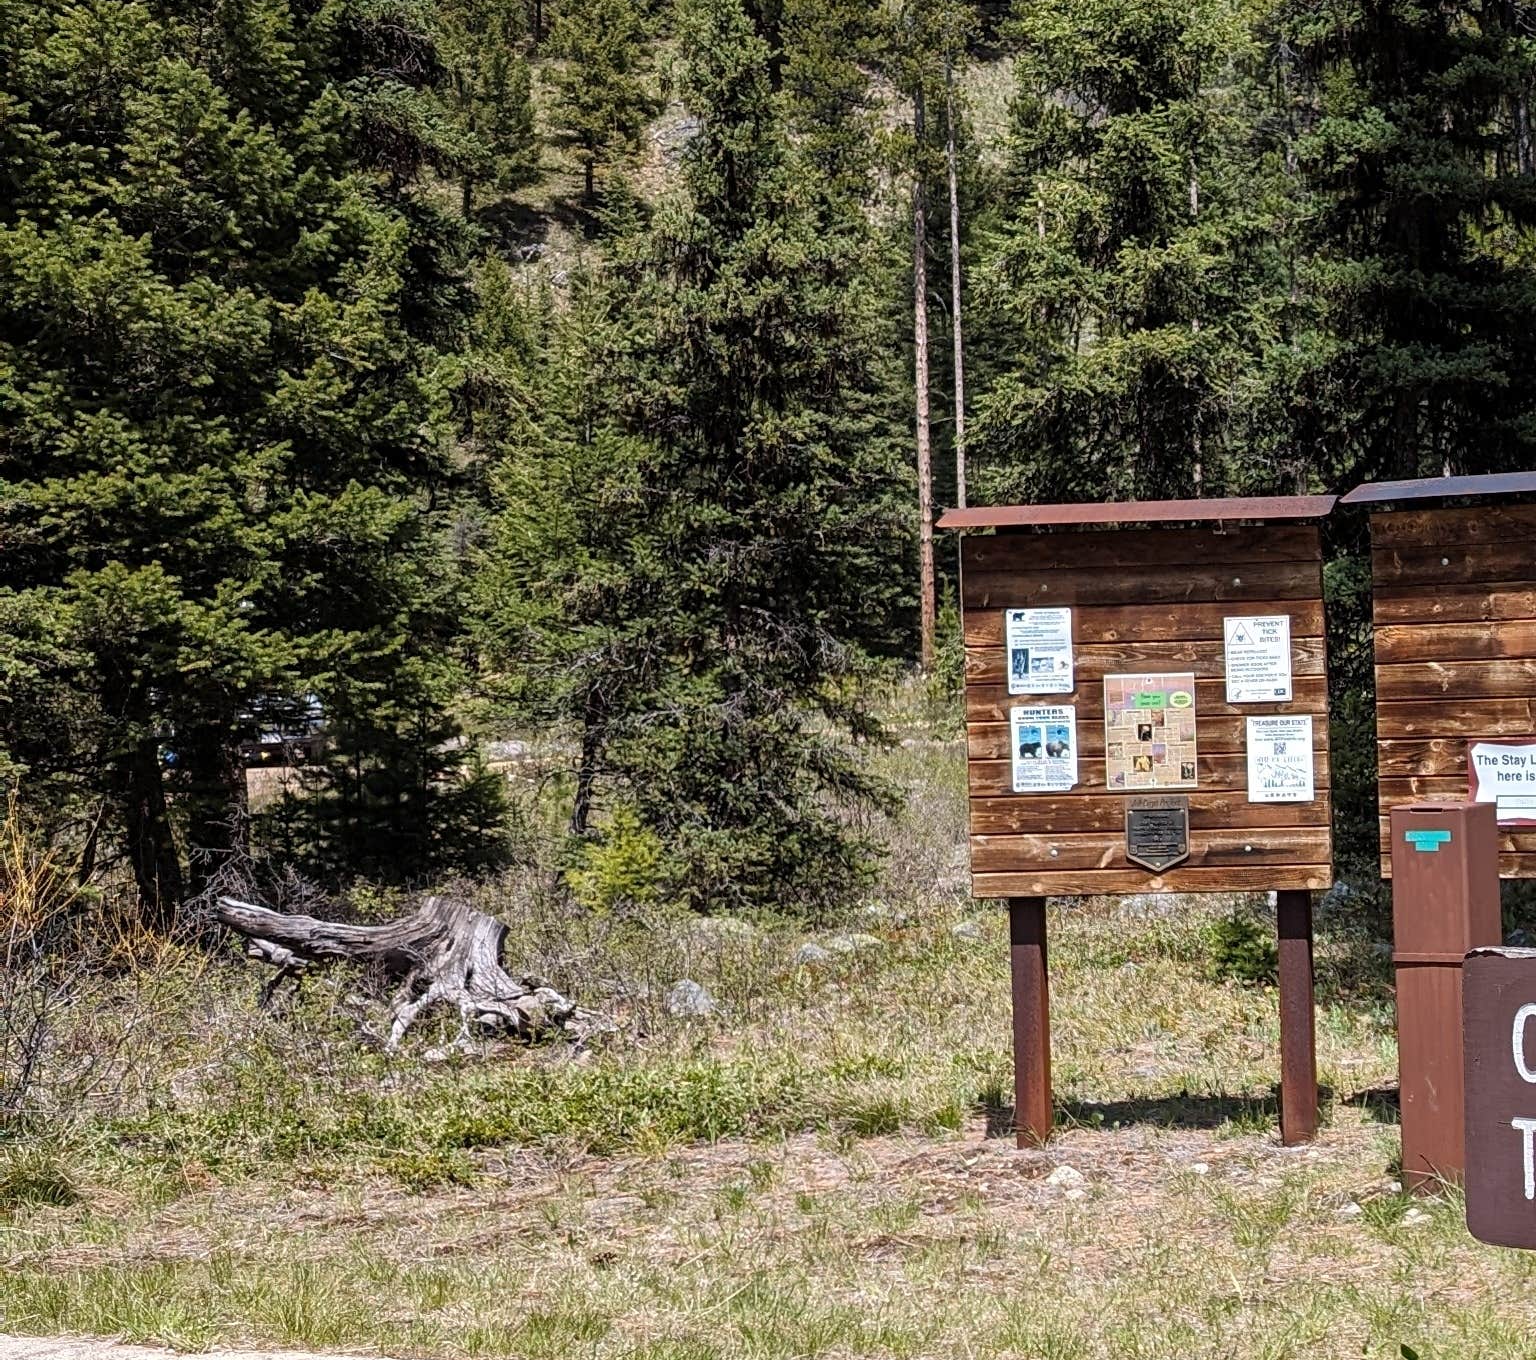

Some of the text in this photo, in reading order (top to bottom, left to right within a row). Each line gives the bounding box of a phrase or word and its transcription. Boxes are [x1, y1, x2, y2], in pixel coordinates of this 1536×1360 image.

[1477, 755, 1498, 765] The
[1502, 755, 1527, 768] Stay
[1497, 771, 1522, 781] here
